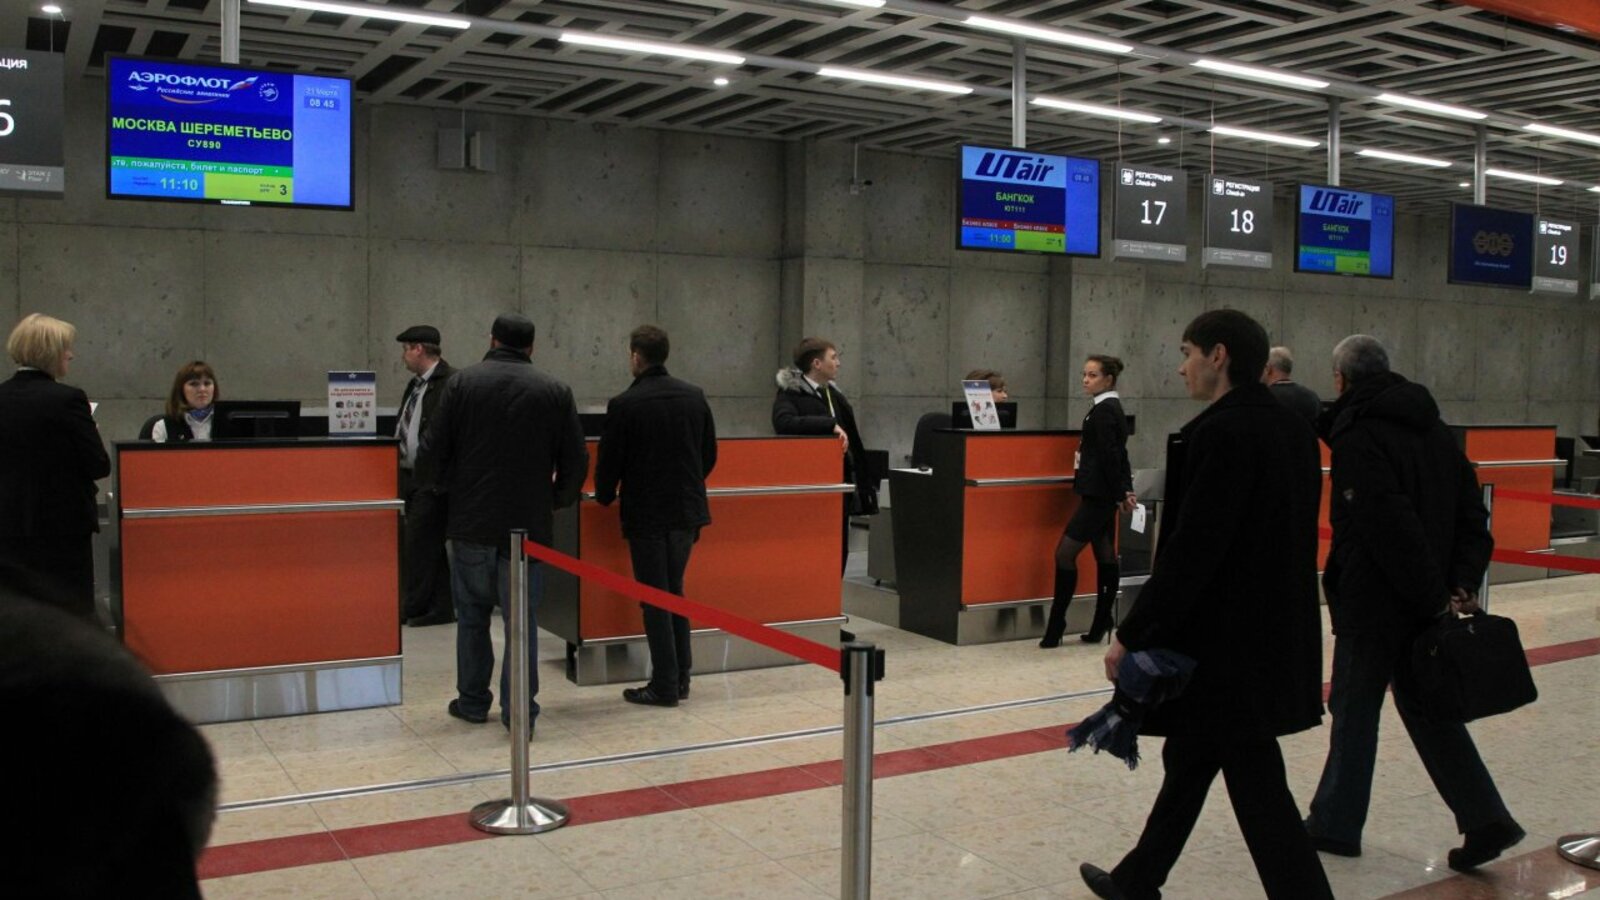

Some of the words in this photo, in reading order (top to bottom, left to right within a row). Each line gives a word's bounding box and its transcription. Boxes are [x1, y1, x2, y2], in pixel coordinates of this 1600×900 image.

[0, 58, 27, 70] ЦИЯ
[128, 71, 231, 89] АЭРОФЛОТ
[112, 117, 177, 133] МОСКВА
[180, 121, 292, 141] ШЕРЕМЕТЬЕВО
[187, 139, 222, 150] СУ890
[131, 161, 188, 172] пожалуйста,
[190, 163, 217, 172] билет
[228, 166, 263, 175] паспорт
[975, 152, 1054, 182] UTair
[160, 177, 198, 191] 11:10
[279, 184, 288, 196] 3
[995, 191, 1035, 204] БАНГКОК
[1309, 190, 1364, 215] UTair
[1140, 199, 1167, 226] 17
[1230, 208, 1255, 235] 18
[1550, 244, 1568, 265] 19
